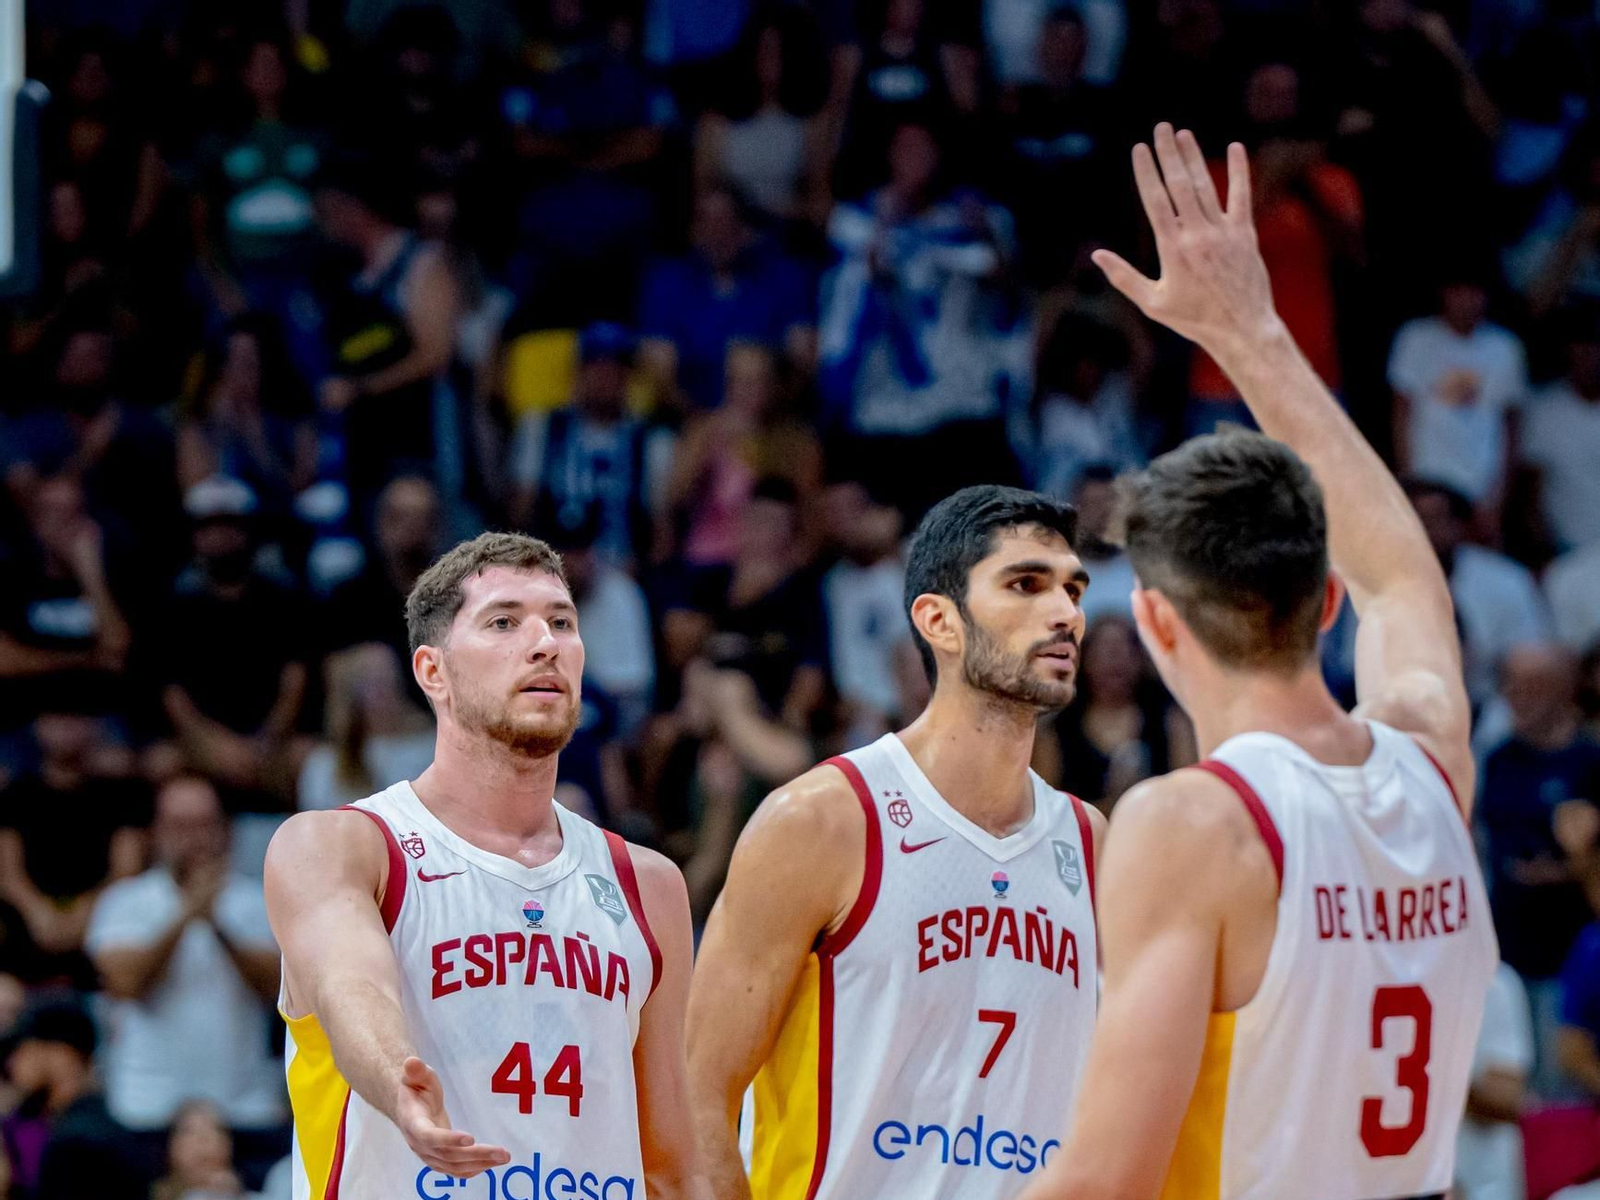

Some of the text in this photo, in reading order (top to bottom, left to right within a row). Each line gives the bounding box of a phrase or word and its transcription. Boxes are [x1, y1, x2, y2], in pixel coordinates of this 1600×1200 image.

[917, 905, 1080, 989] ESPAÑA
[1313, 884, 1352, 942] DE
[430, 930, 631, 1011] ESPAÑA
[490, 1041, 584, 1118] 44
[977, 1008, 1017, 1079] 7
[1359, 984, 1434, 1159] 3
